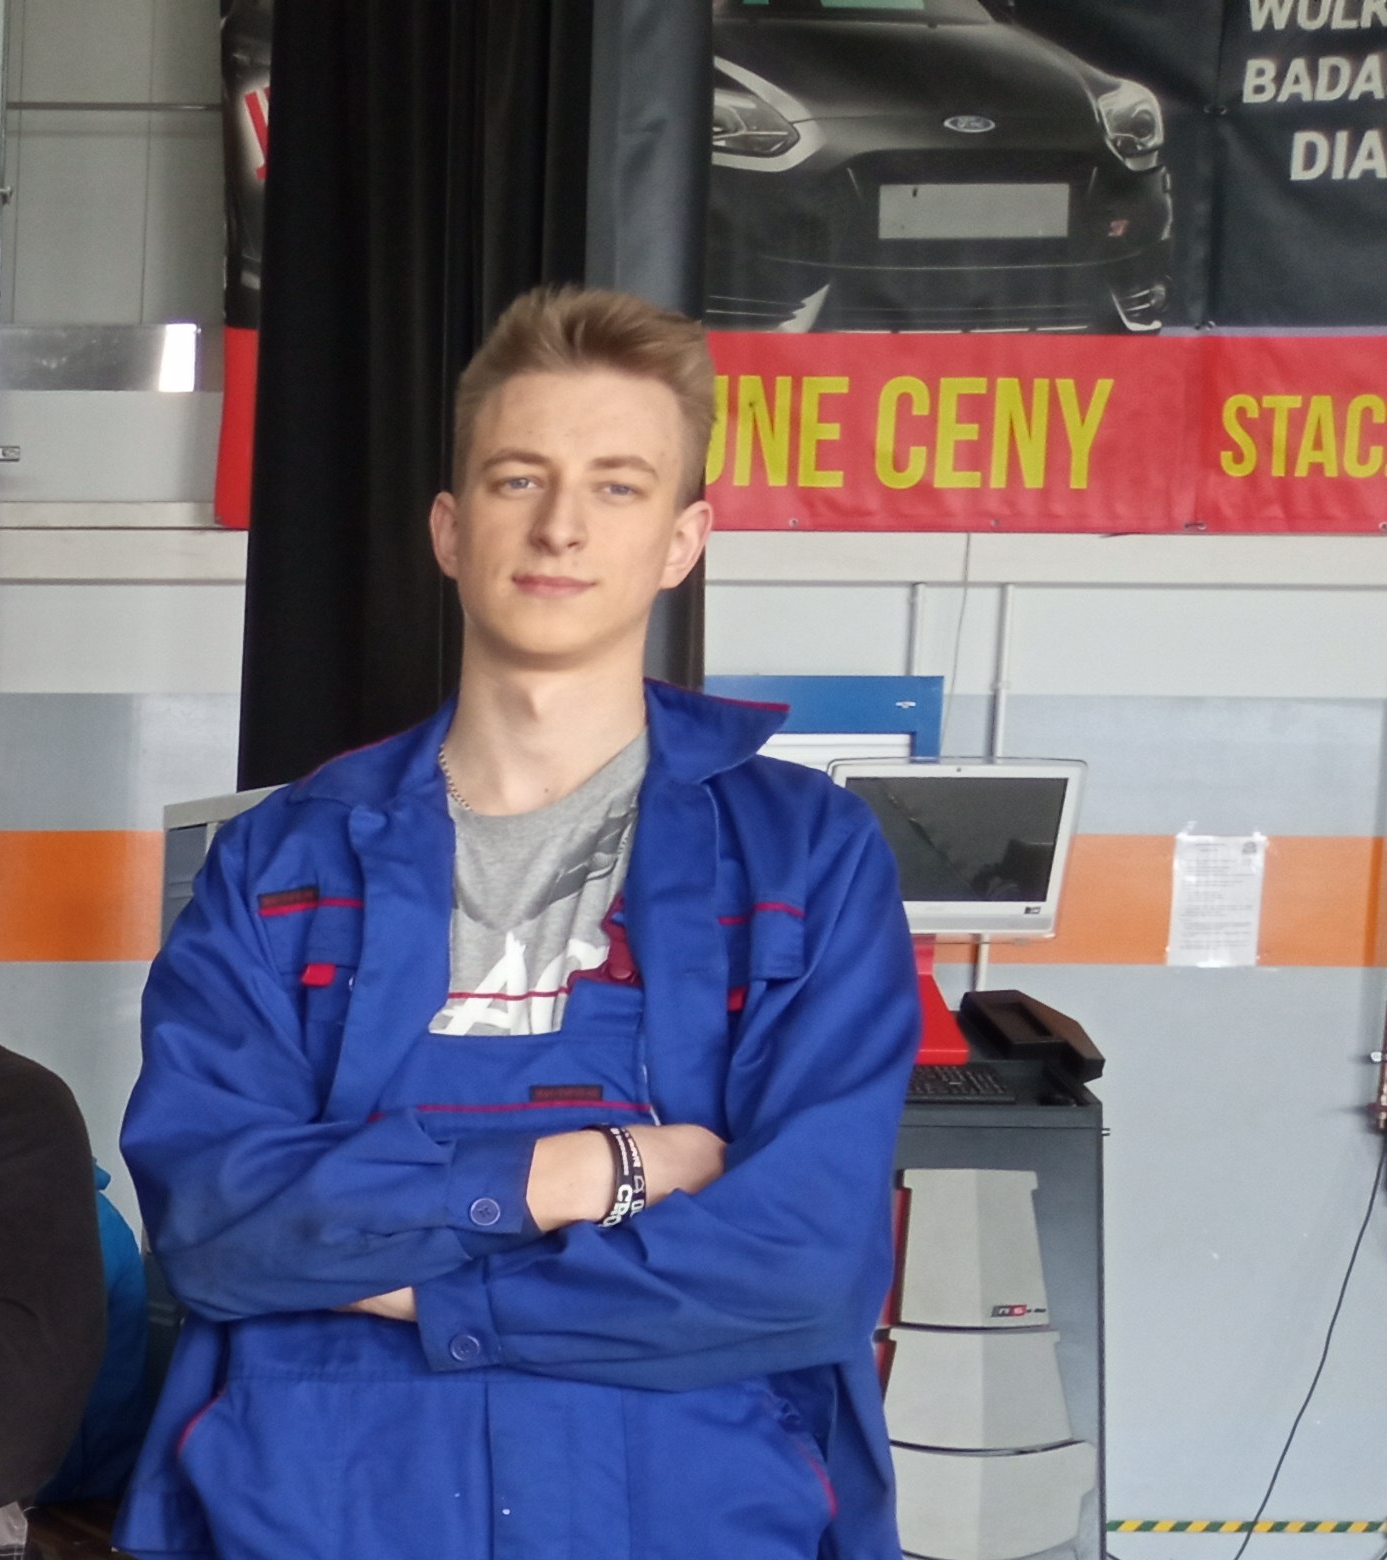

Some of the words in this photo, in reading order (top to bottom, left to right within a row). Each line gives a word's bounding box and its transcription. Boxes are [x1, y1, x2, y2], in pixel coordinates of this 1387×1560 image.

[1242, 54, 1385, 103] BADA
[1290, 129, 1387, 181] DIA
[875, 376, 1115, 489] CENY
[1220, 394, 1387, 478] STAC
